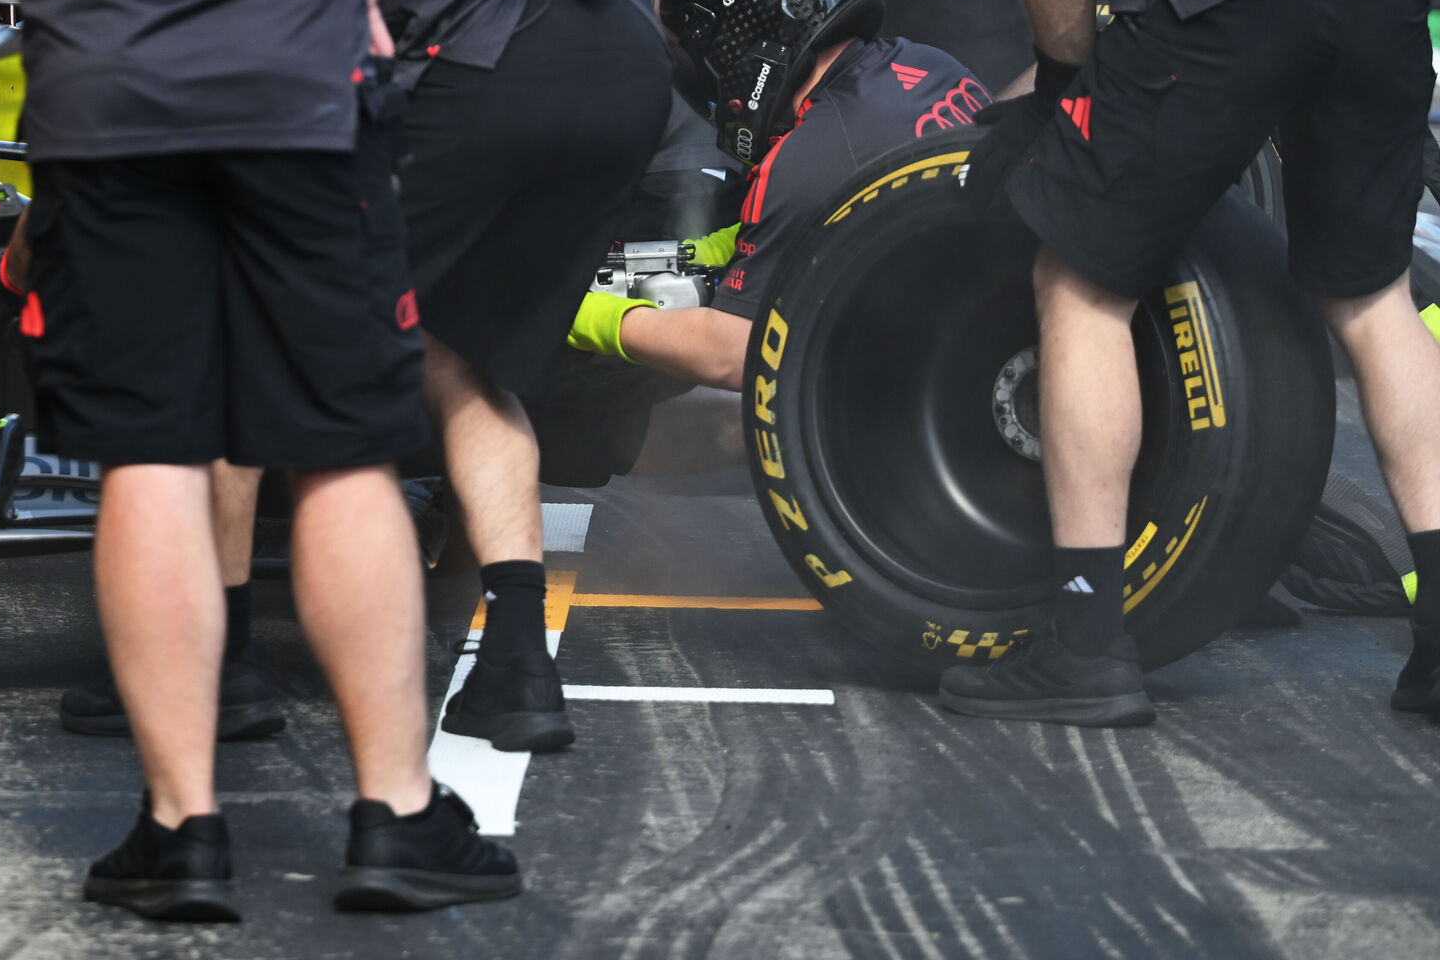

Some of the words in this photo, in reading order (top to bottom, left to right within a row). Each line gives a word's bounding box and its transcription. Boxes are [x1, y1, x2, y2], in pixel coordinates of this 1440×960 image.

[751, 62, 772, 101] Castrol
[1163, 280, 1226, 431] PIRELLI
[755, 307, 809, 531] ZERO
[804, 553, 853, 588] P
